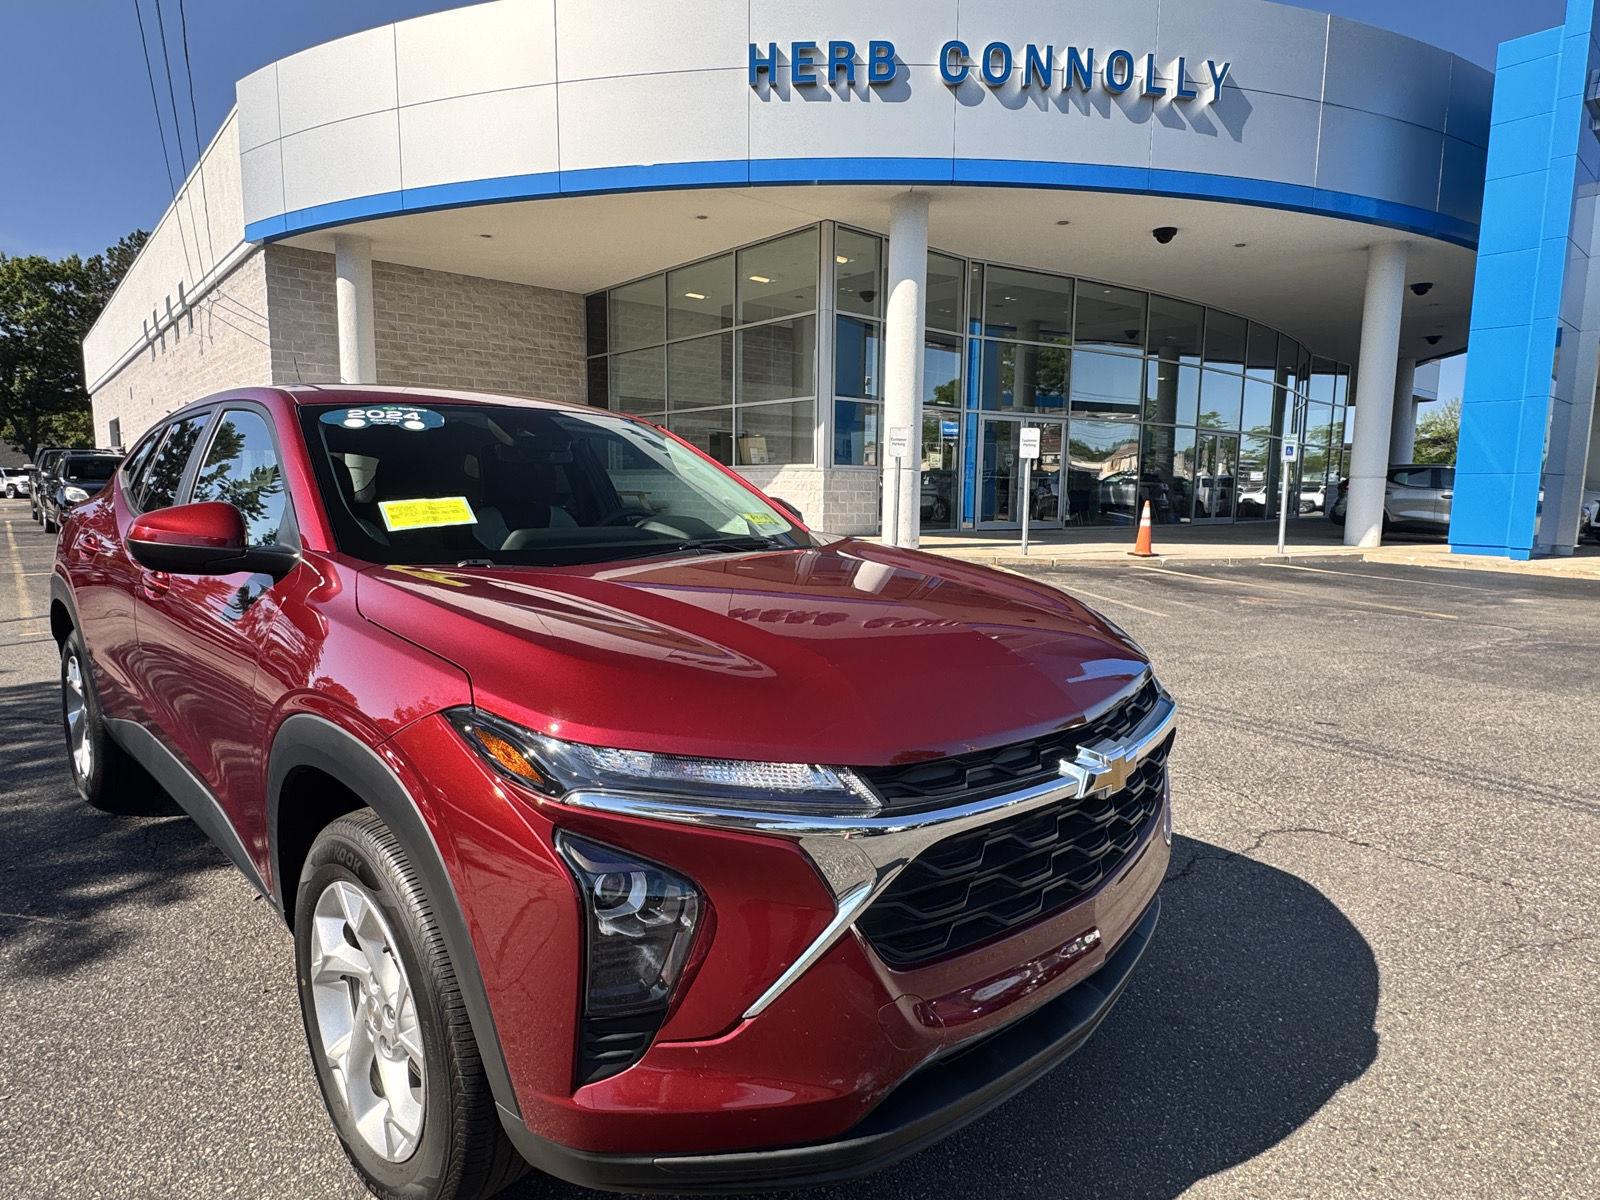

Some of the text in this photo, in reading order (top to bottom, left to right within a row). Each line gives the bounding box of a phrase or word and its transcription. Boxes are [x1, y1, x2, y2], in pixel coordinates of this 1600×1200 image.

[748, 40, 1231, 103] HERB CONNOLLY
[347, 409, 421, 421] 2024
